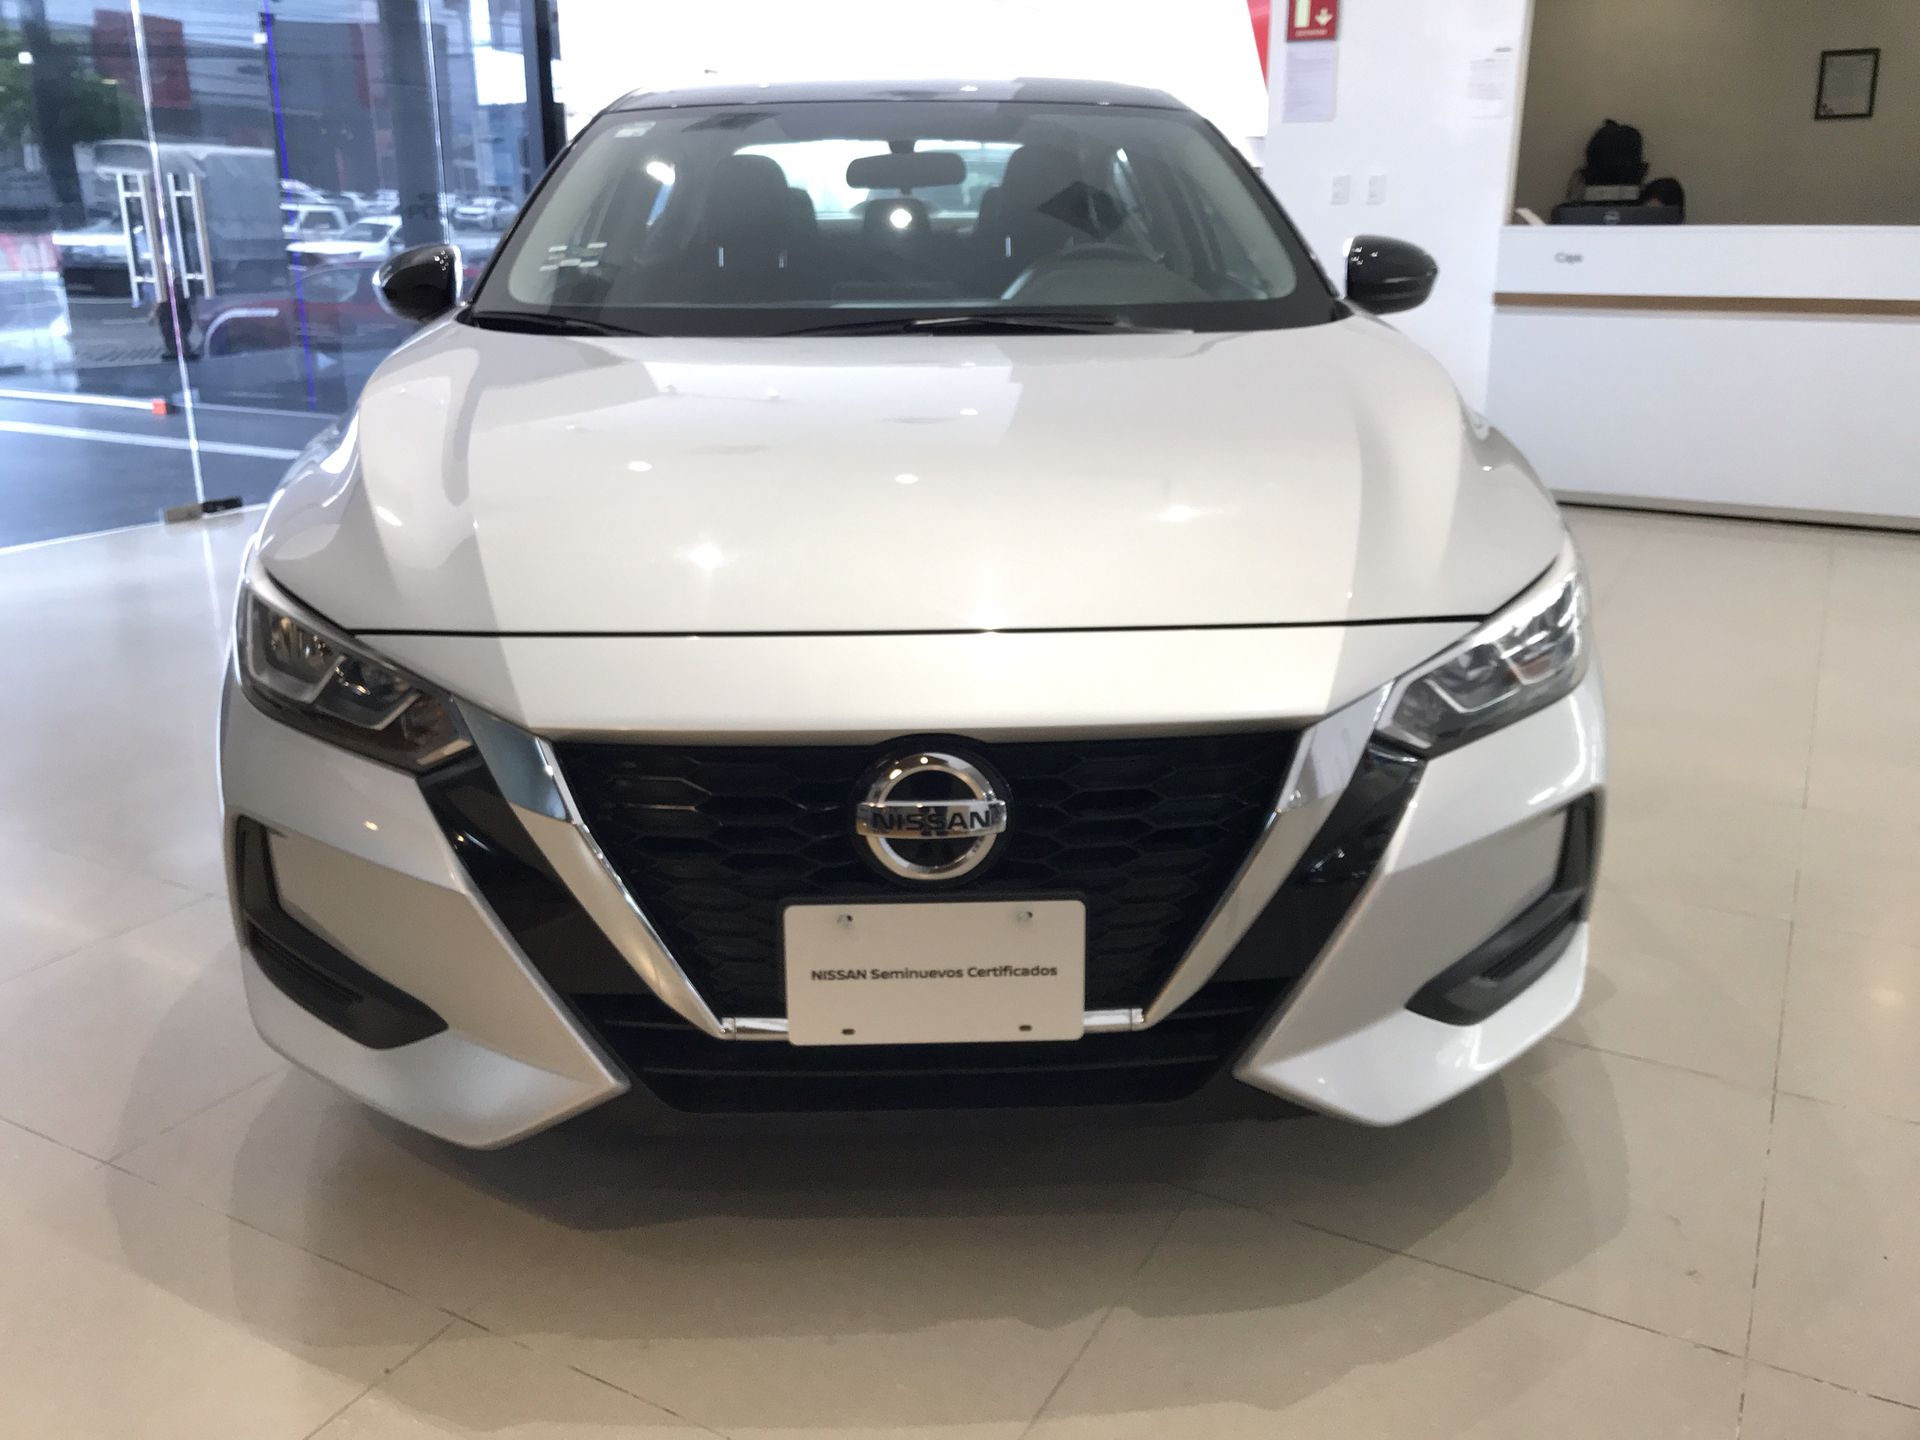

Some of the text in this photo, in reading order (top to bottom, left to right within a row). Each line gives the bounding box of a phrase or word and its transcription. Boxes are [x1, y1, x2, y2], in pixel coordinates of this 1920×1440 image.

[872, 810, 991, 832] NISSAN
[811, 965, 1058, 982] NISSAN Seminuevos Certificados
